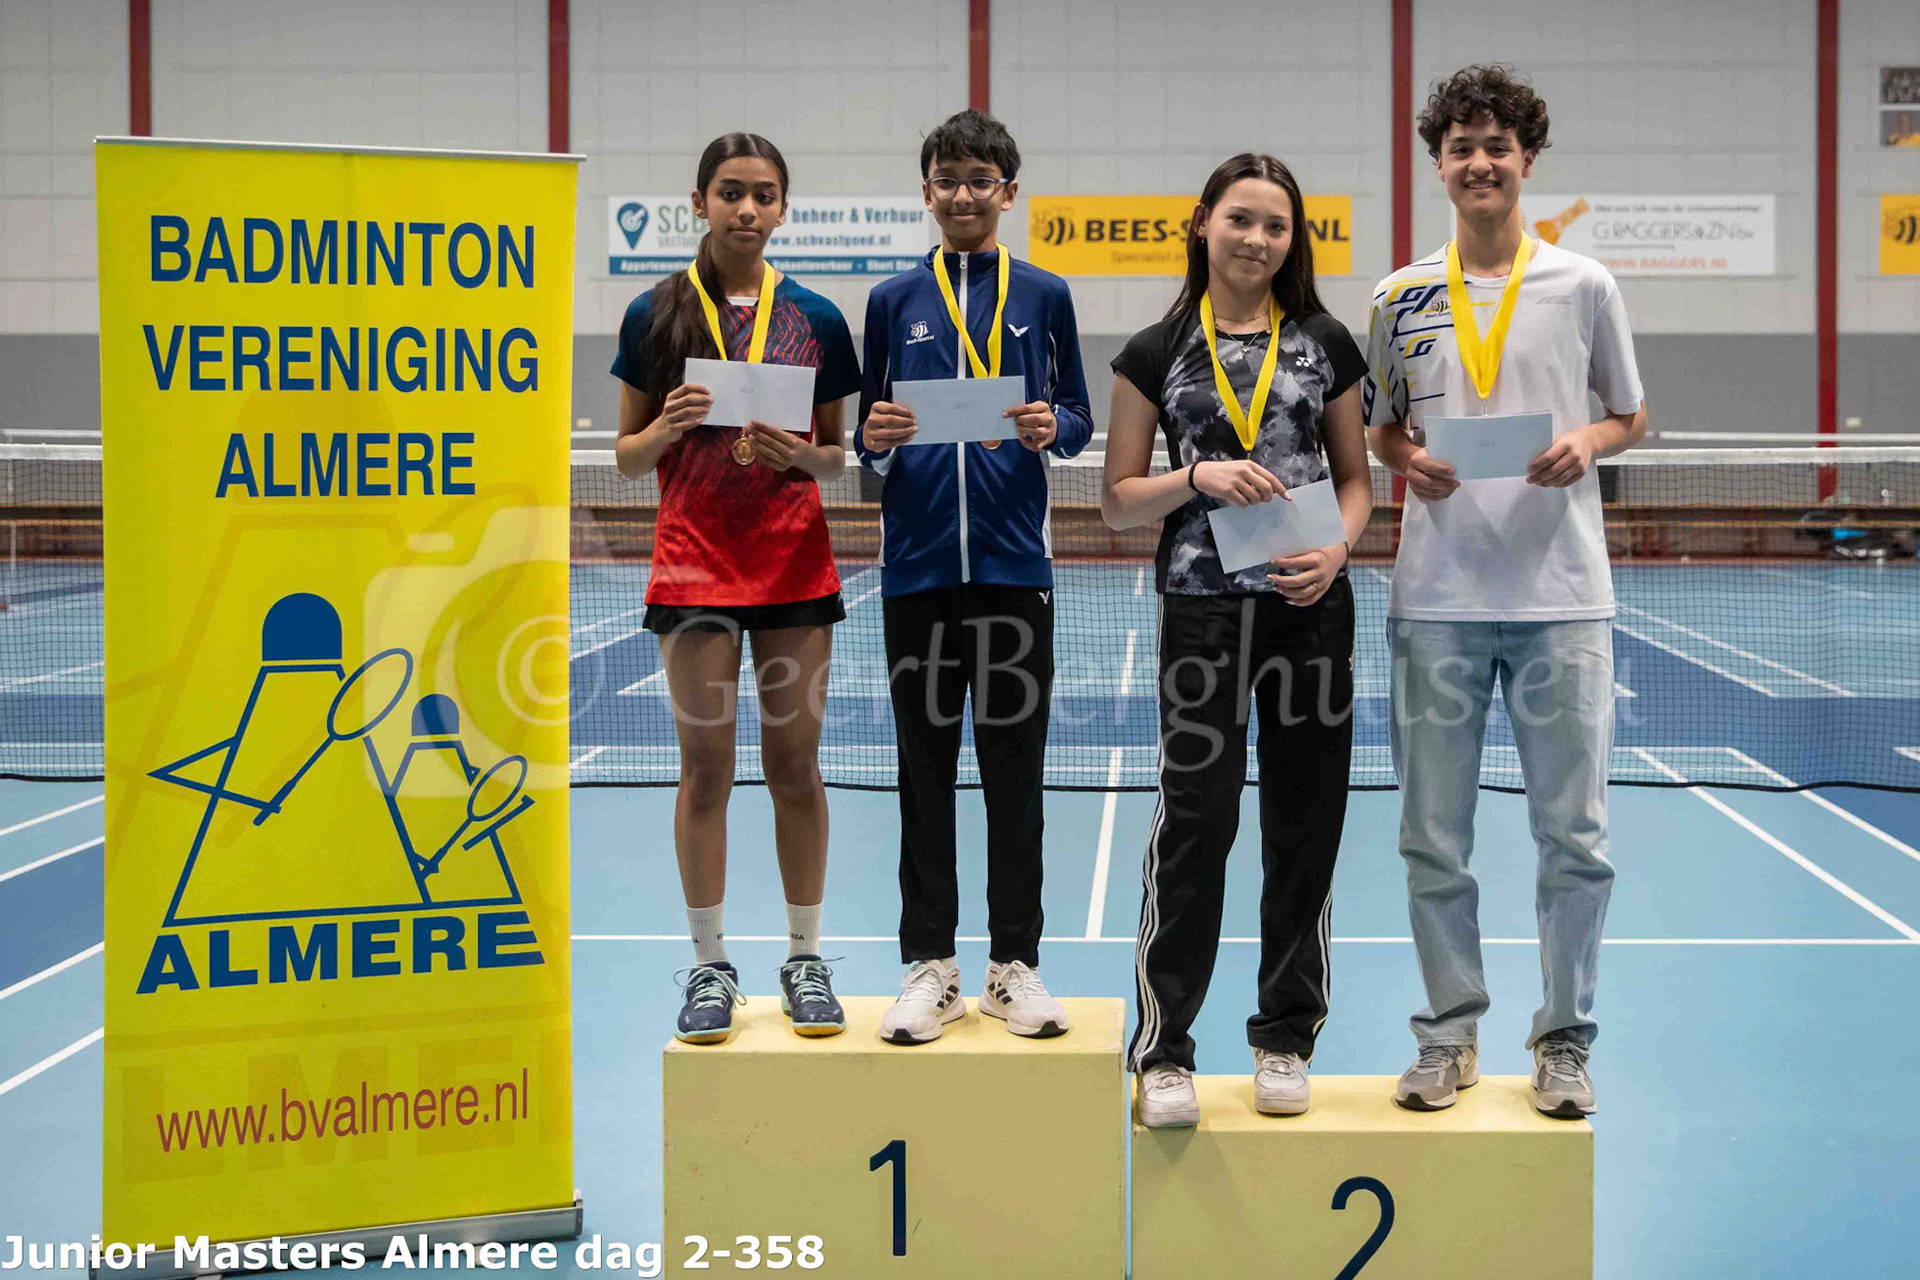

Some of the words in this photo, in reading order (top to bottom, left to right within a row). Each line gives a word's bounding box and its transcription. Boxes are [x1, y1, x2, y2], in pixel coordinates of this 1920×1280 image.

[151, 215, 534, 289] BADMINTON
[769, 234, 892, 247] ww.scbvastgoed.nl
[792, 207, 844, 223] beheer
[850, 207, 859, 223] &
[865, 207, 924, 223] Verhuur
[143, 324, 538, 393] VERENIGING
[215, 432, 475, 498] ALMERE
[136, 911, 545, 995] ALMERE
[156, 1068, 529, 1153] www.bvalmere.nl
[869, 1140, 906, 1256] 1
[1331, 1176, 1395, 1280] 2
